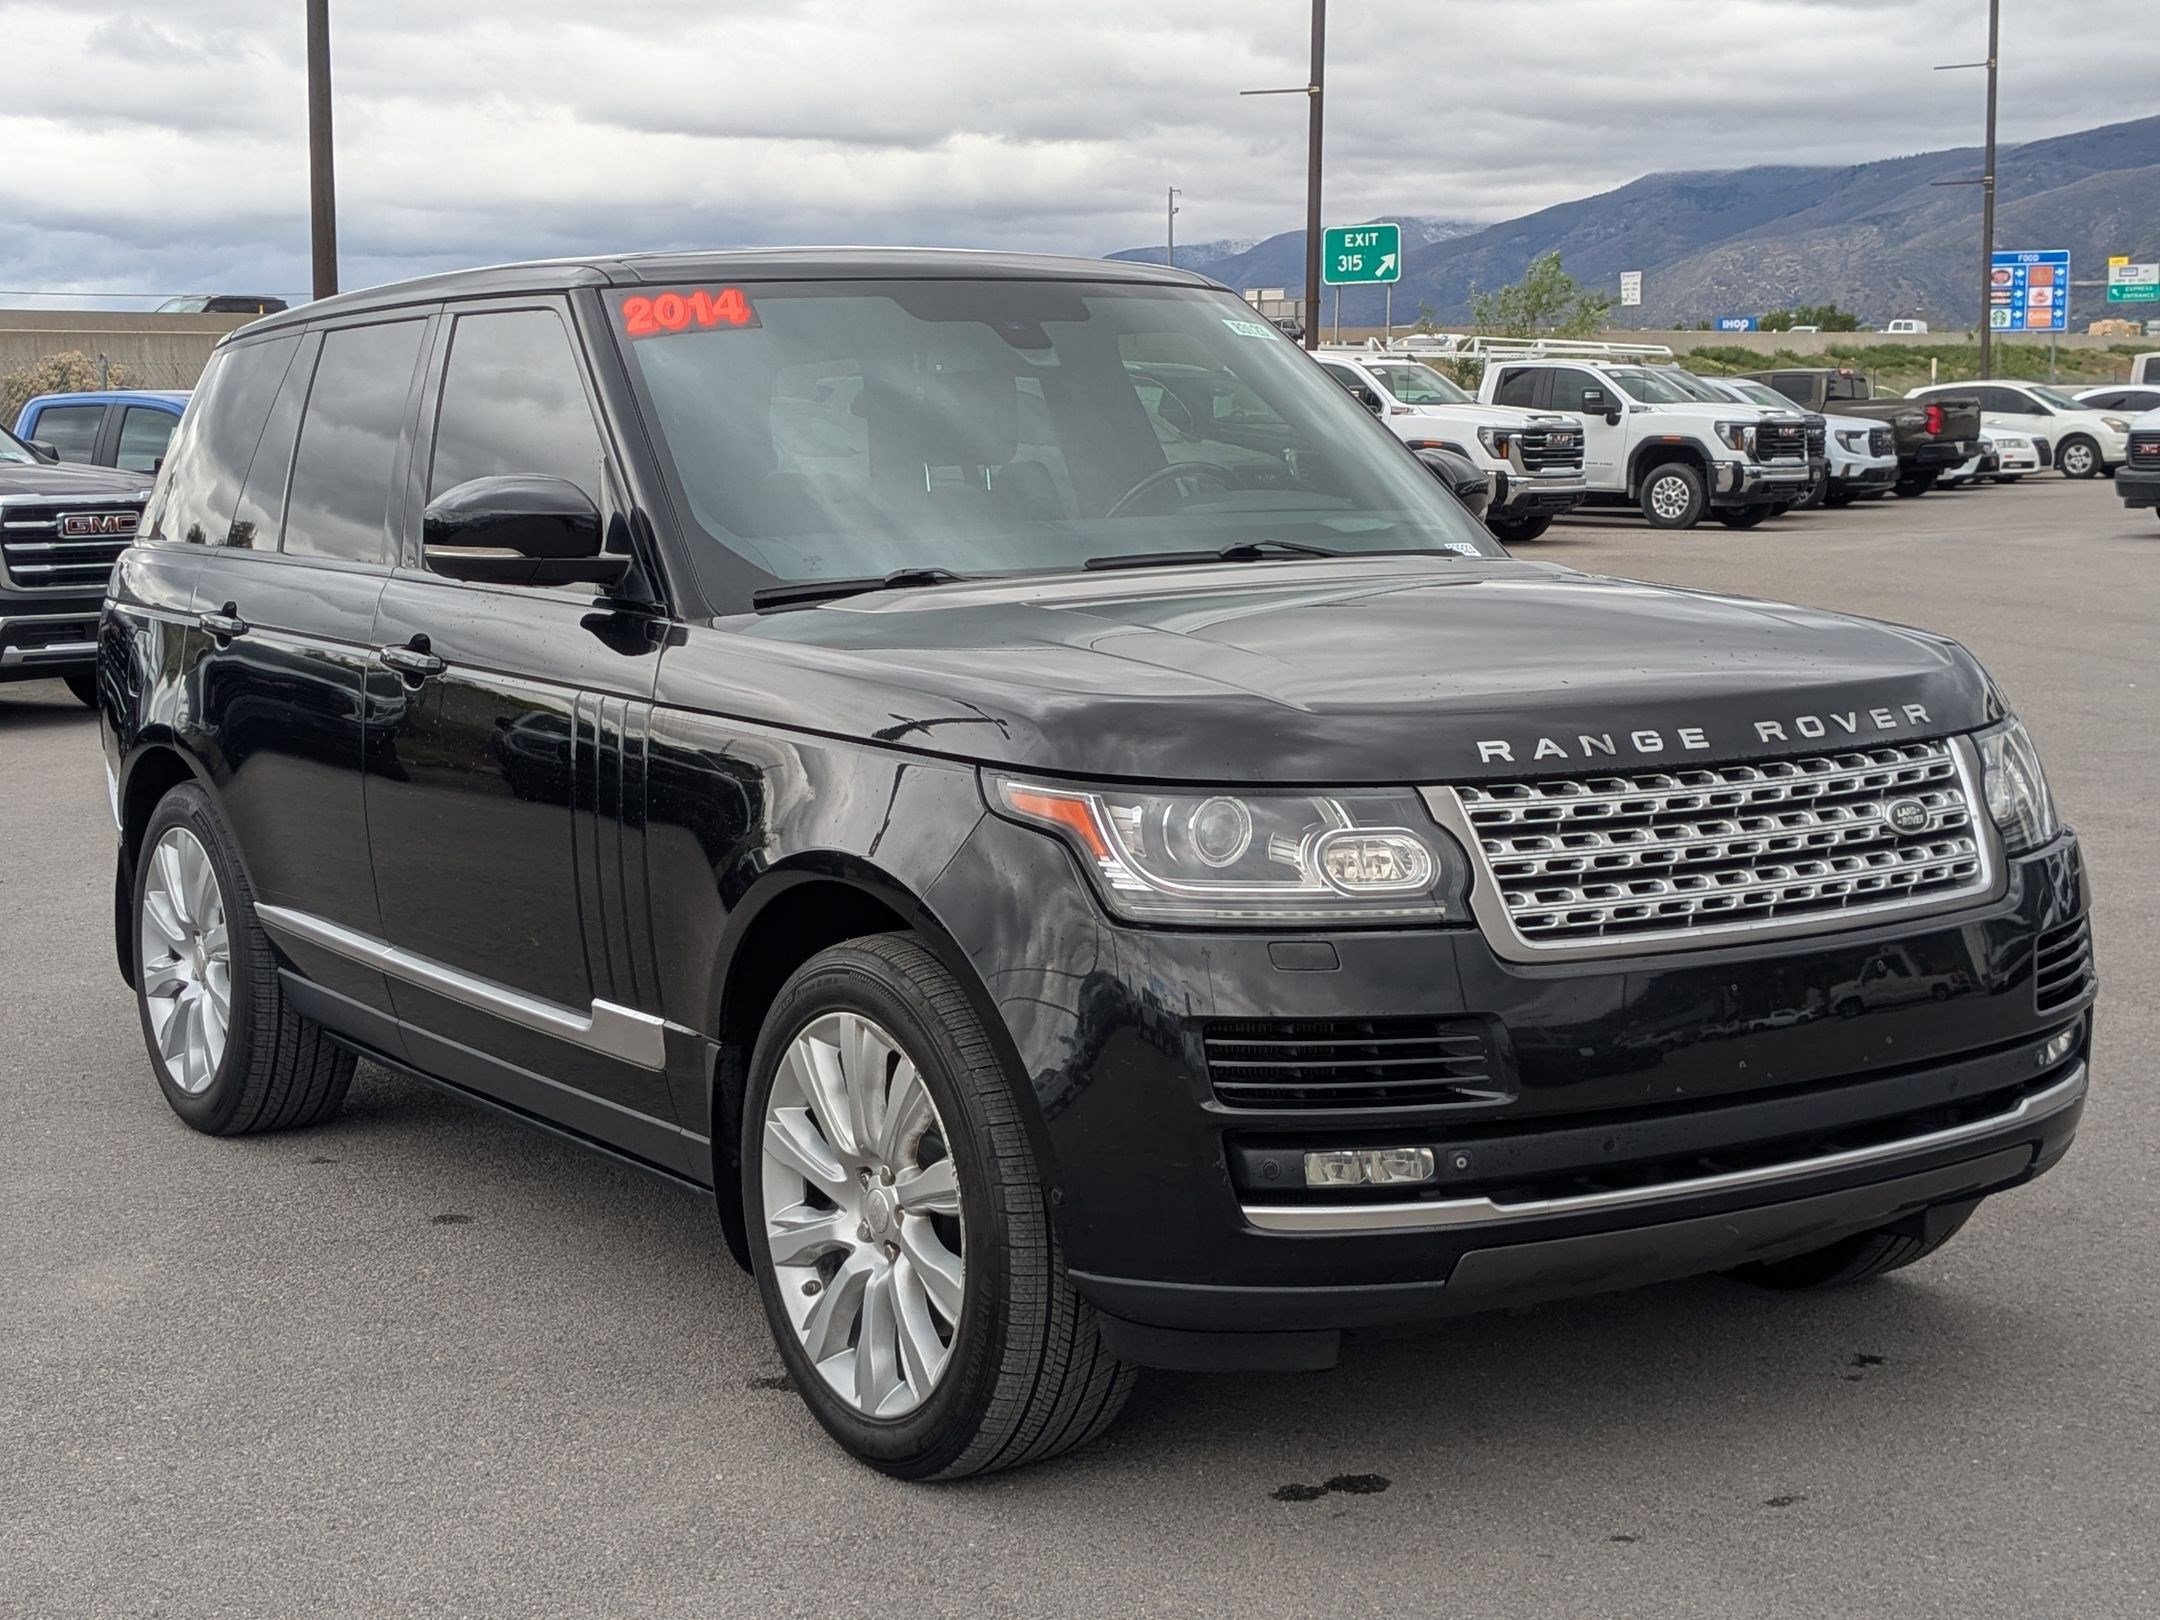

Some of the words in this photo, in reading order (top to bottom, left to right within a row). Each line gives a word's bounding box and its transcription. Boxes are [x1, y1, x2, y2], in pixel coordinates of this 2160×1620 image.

[1344, 232, 1379, 247] EXIT
[1337, 253, 1363, 272] 315
[2017, 254, 2040, 262] FOOD
[623, 287, 751, 335] 2014
[65, 515, 138, 534] GMC
[1476, 728, 1710, 763] RANGE
[1754, 704, 1931, 743] ROVER
[1896, 806, 1917, 818] LAND
[1902, 814, 1924, 826] ROVER
